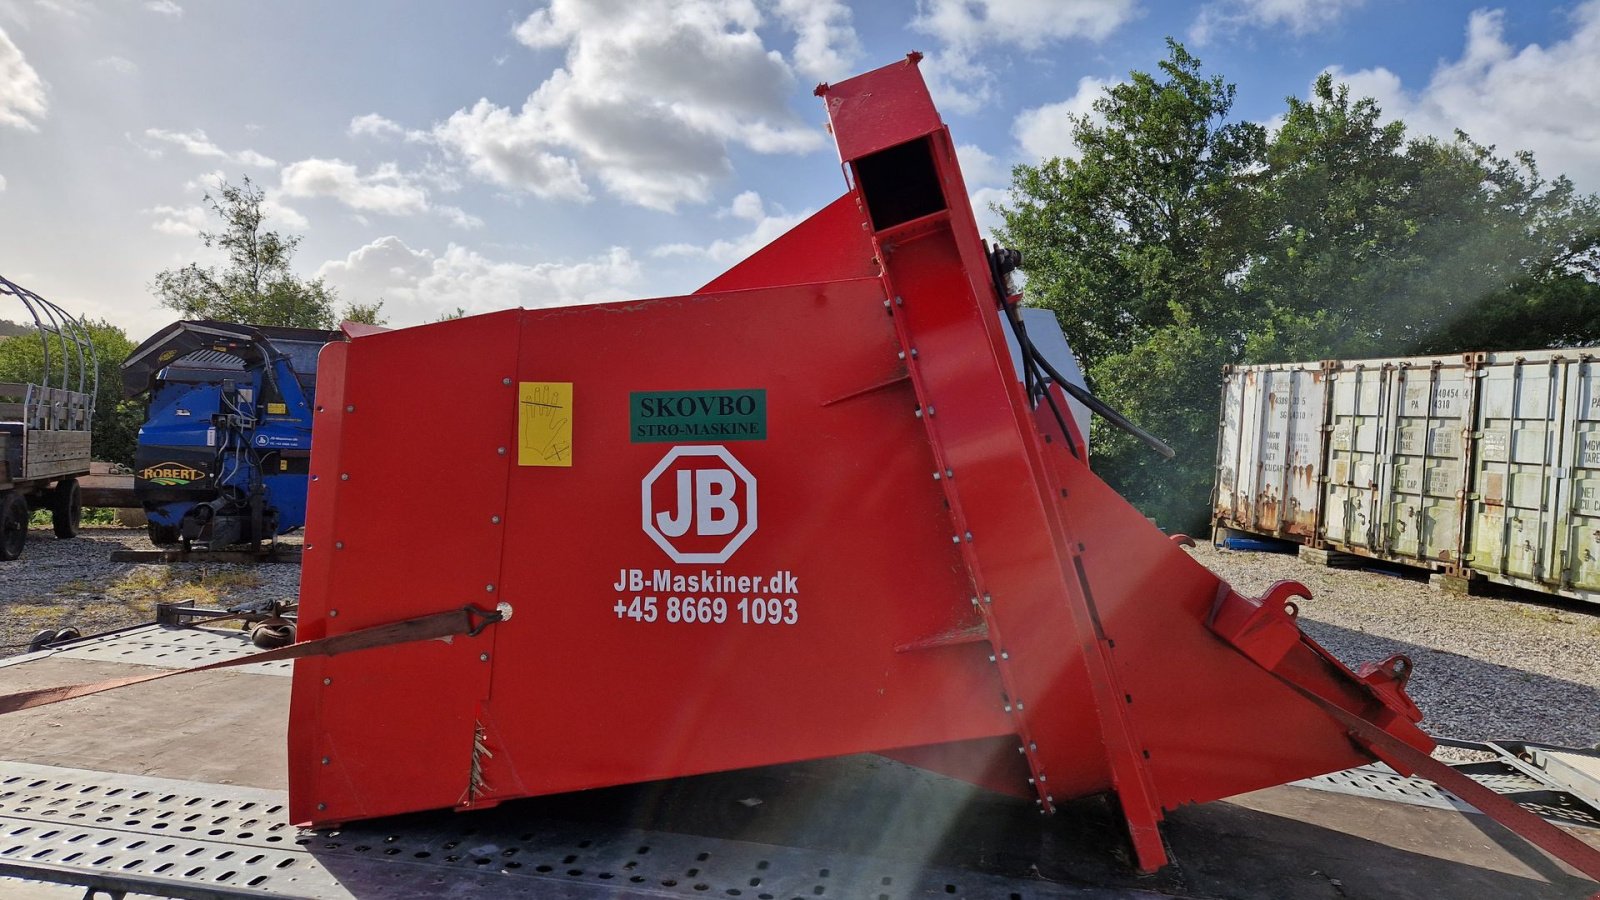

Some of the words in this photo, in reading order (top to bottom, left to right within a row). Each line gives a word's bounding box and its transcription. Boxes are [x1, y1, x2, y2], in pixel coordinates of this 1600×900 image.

[641, 394, 756, 418] SKOVBO
[1411, 400, 1419, 409] PA
[637, 421, 759, 438] STRØ-MASKINE
[144, 468, 198, 480] ROBERT
[655, 467, 739, 538] JB
[613, 568, 799, 594] JB-Maskiner.dk
[613, 595, 659, 623] +45
[666, 596, 728, 624] 8669
[736, 597, 799, 625] 1093
